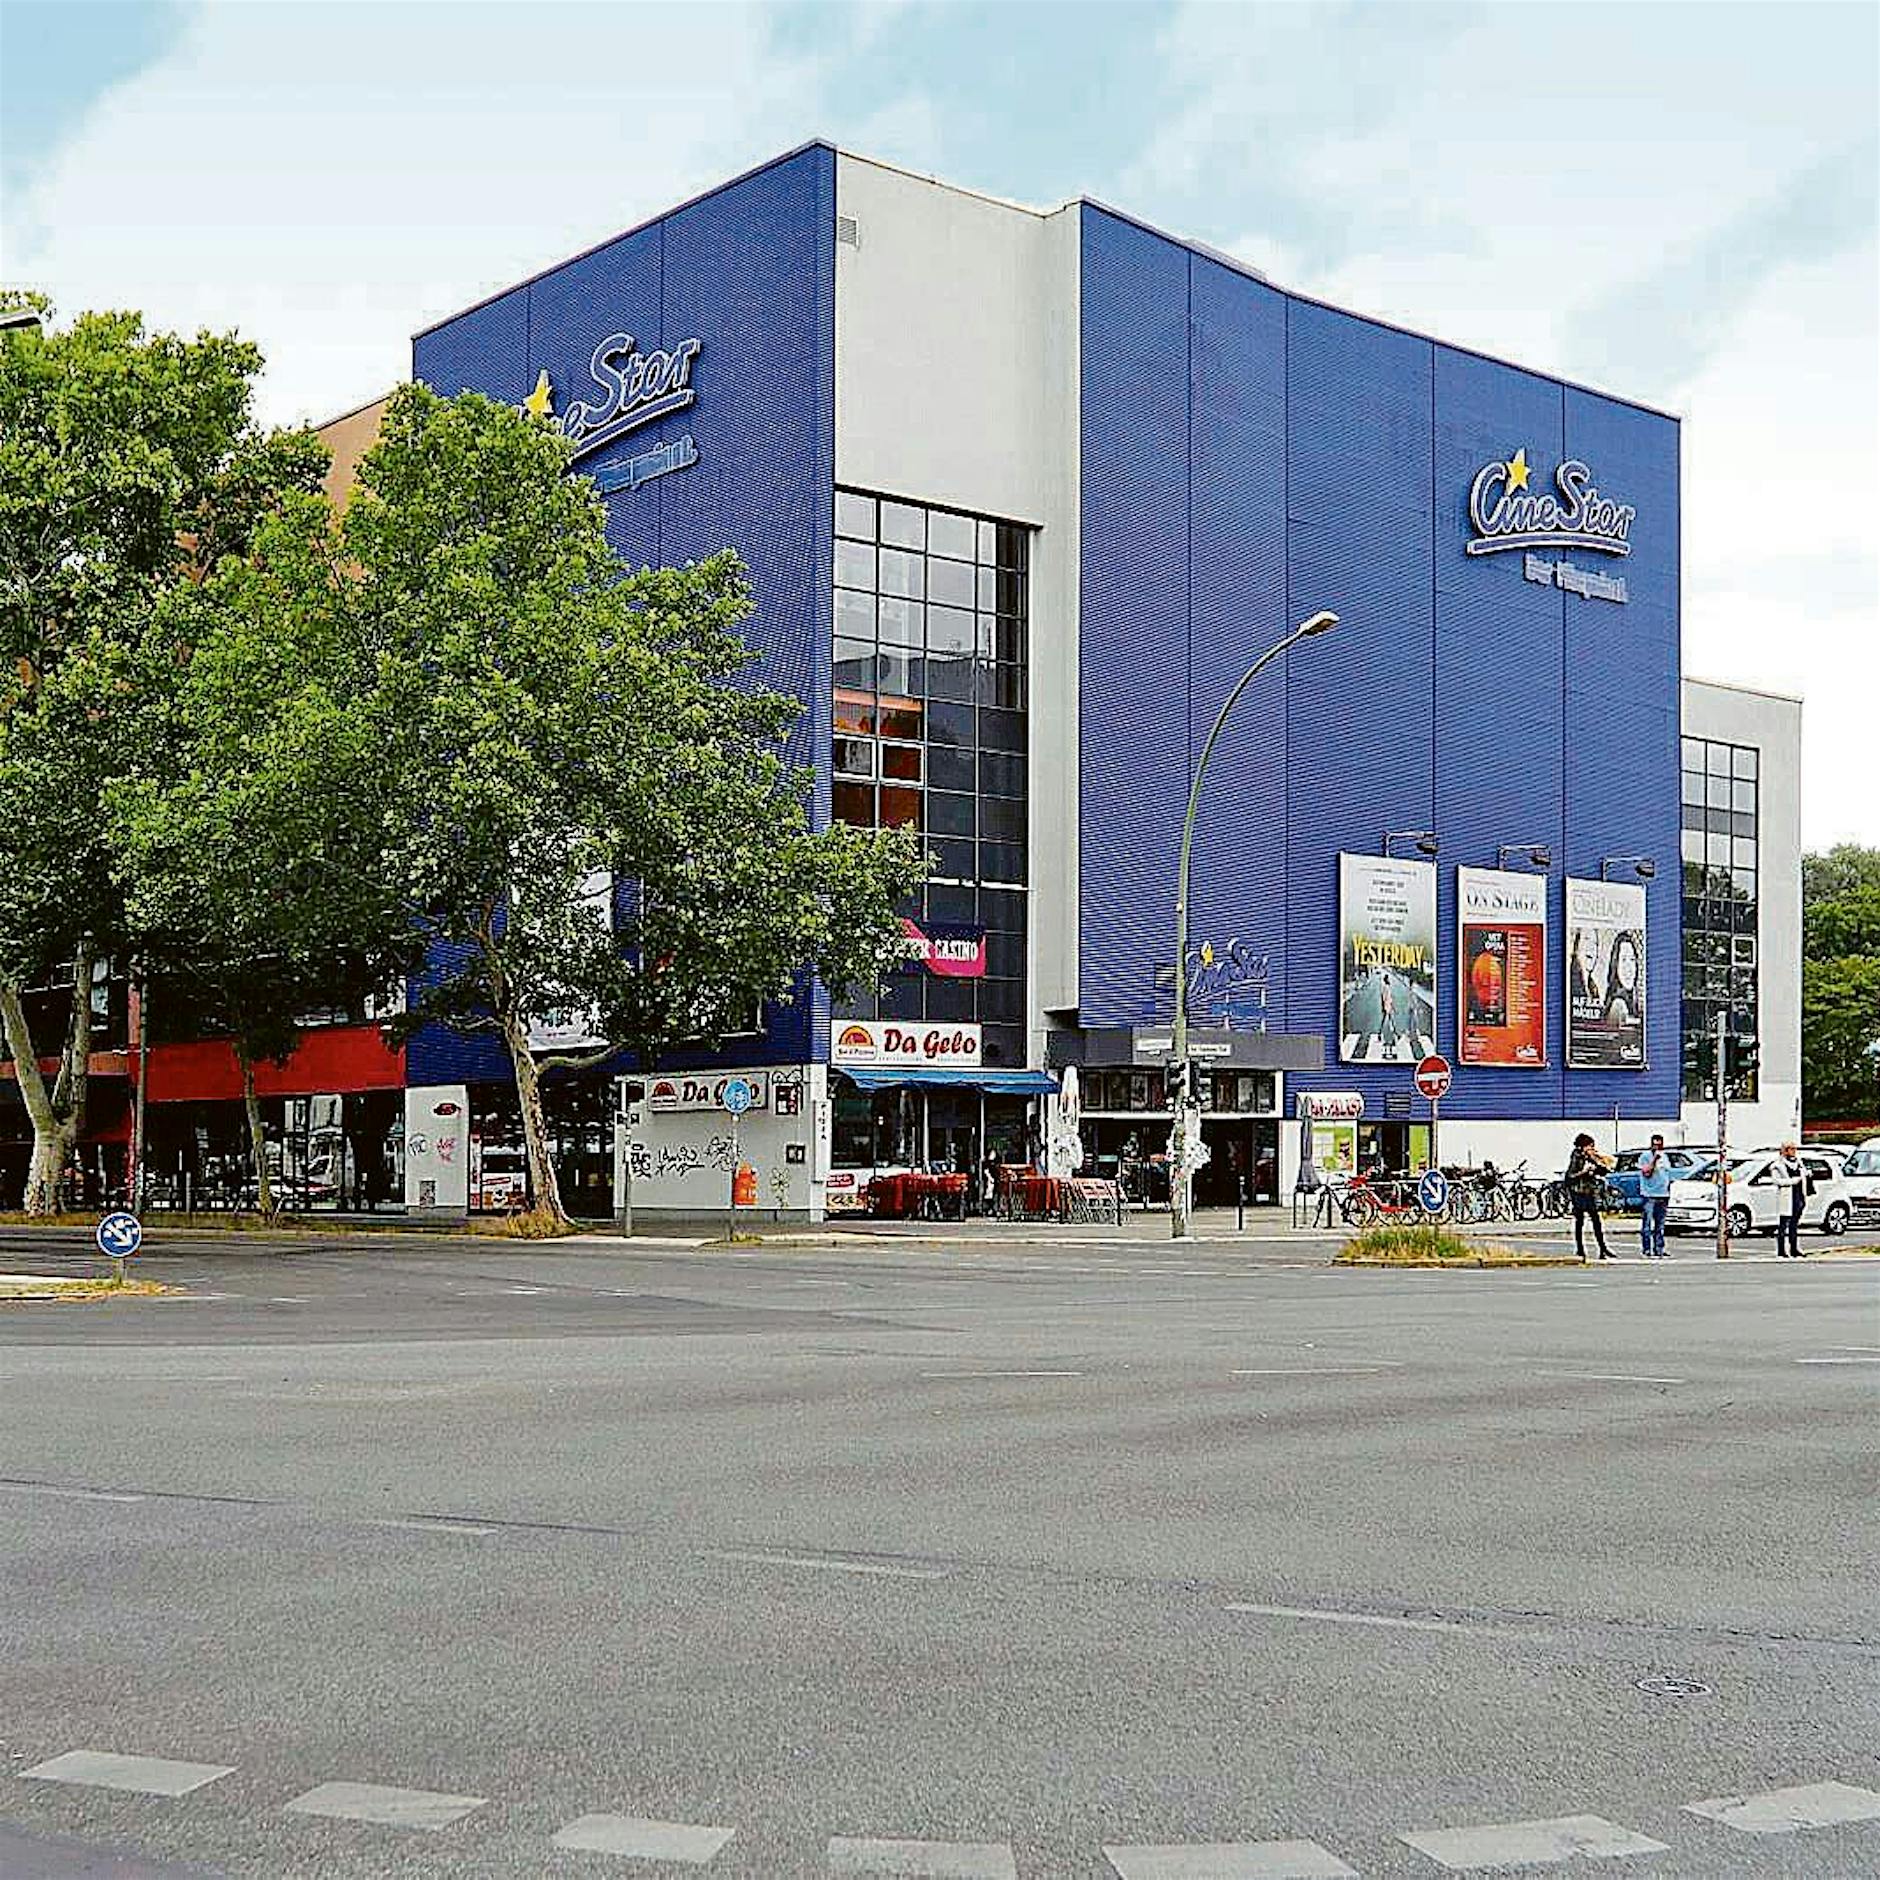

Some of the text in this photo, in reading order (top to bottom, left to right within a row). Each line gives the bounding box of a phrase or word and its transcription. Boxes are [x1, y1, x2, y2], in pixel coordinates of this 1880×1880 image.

[1470, 458, 1636, 540] CineStar
[935, 940, 979, 961] CASINO
[1353, 933, 1424, 972] YESTERDAY
[884, 1028, 917, 1054] Da
[923, 1030, 977, 1059] Gelo
[682, 1078, 760, 1106] Da Go
